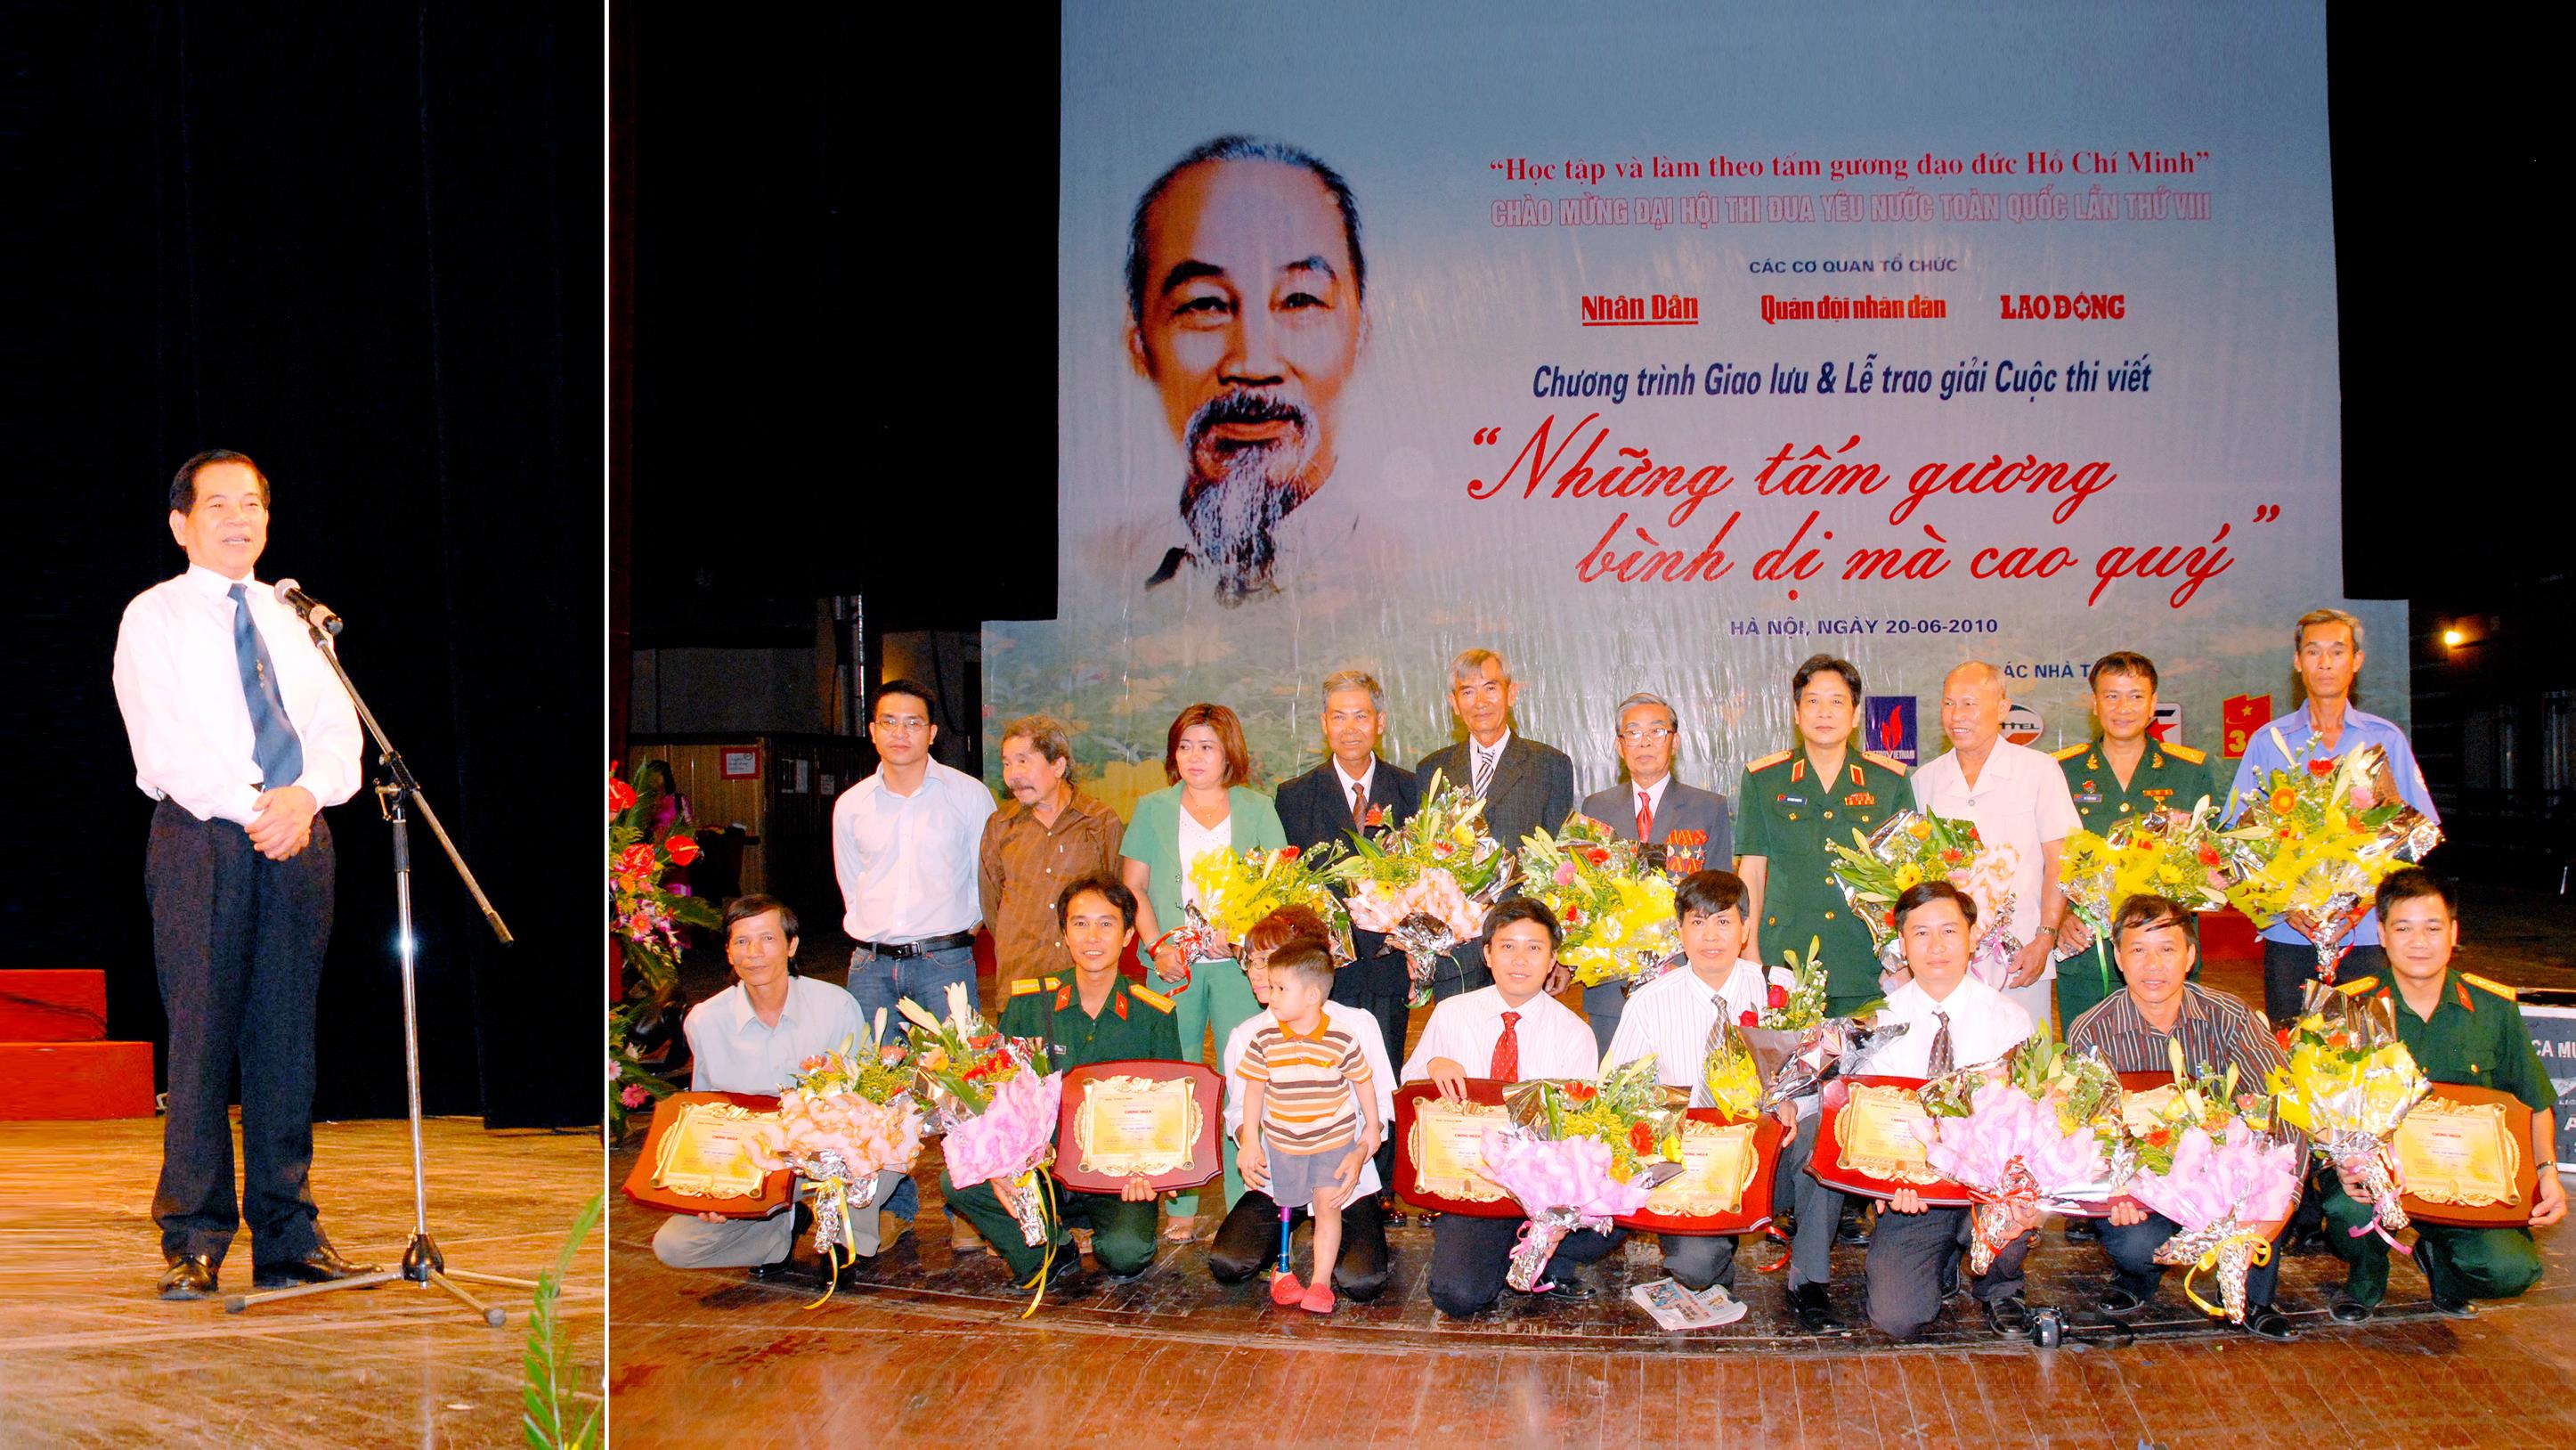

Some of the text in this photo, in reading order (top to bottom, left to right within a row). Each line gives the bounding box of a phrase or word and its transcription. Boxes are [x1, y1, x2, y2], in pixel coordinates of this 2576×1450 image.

[1565, 157, 1605, 185] tập
[1615, 155, 1643, 179] và
[1654, 156, 1700, 178] làm
[1710, 155, 1764, 178] theo
[1772, 151, 1821, 178] tấm
[1831, 157, 1909, 181] gương
[1917, 153, 1963, 180] đạo
[1971, 152, 2017, 175] đức
[2072, 151, 2117, 175] Chí
[2127, 151, 2209, 175] Minh”
[1491, 193, 1552, 228] CHÀO
[1559, 191, 1629, 227] MỪNG
[1634, 197, 1673, 231] ĐẠI
[1680, 191, 1719, 229] HỘI
[1724, 196, 1760, 224] THI
[1767, 196, 1816, 223] ĐUA
[1821, 190, 1864, 223] YÊU
[1870, 186, 1933, 223] NƯỚC
[1940, 188, 2000, 223] TOÀN
[2007, 183, 2068, 224] QUỐC
[2125, 183, 2170, 221] THỨ
[2173, 191, 2212, 222] VIII
[1749, 253, 1957, 273] CÁC CƠ QUAN TỔ CHỨC
[1581, 295, 1699, 321] Nhân Dân
[1760, 294, 1946, 324] Quân đội nhân dân
[2000, 294, 2051, 320] LAO
[1532, 354, 2151, 405] Chương trình Giao lưu & Lễ trao giải Cuộc thi viết
[1754, 435, 1889, 496] tấm
[1889, 454, 2117, 525] gương
[1575, 512, 1741, 583] bình
[1752, 510, 1833, 601] dị
[1841, 524, 1951, 580] mà
[1971, 546, 2078, 579] cao
[1730, 615, 1999, 639] HÀ NỘI, NGÀY 20-06-2010
[2004, 660, 2028, 678] ÁC
[2035, 660, 2074, 678] NHÀ
